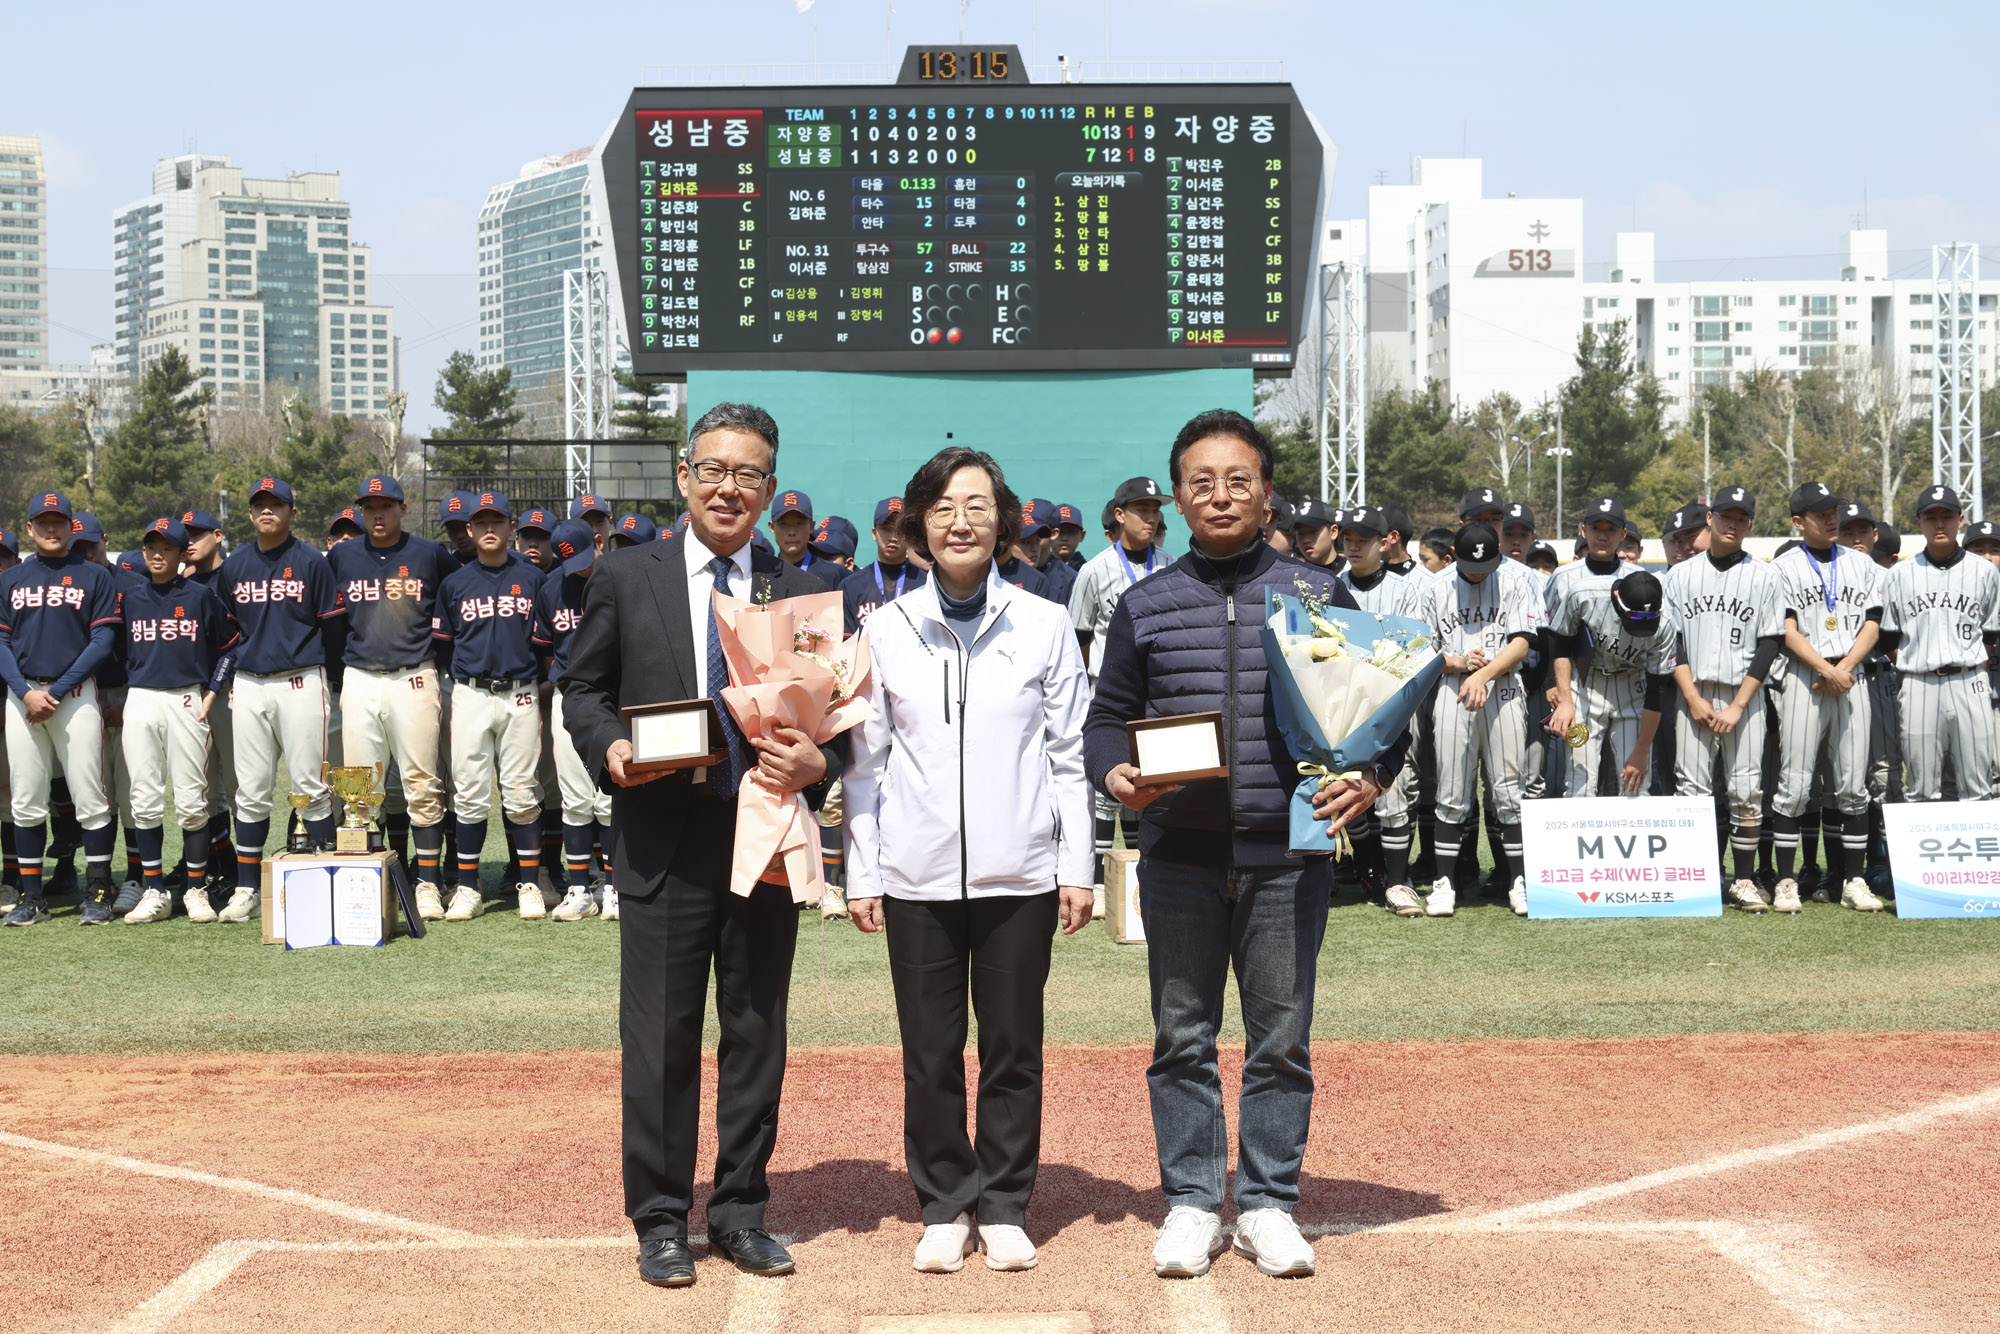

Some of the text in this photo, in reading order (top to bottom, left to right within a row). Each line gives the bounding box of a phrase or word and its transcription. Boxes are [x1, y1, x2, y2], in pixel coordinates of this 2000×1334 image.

[921, 52, 1009, 79] 13:15
[785, 107, 1075, 121] TEAM 1 2 3 4 5 6 7 8 9 10 11 12
[1086, 106, 1154, 118] R H E B
[649, 119, 749, 147] 성남중
[778, 125, 1155, 142] 자양중 1 0 4 0 2 0 3 10 13 1 9
[1175, 116, 1275, 143] 자양중
[778, 148, 1155, 164] 성남중 1 1 3 2 0 0 0 7 12 1 8
[660, 163, 752, 177] 강규명 SS
[1266, 160, 1281, 170] 2B
[661, 182, 754, 195] 김하준 2B
[861, 178, 936, 191] 타율 0.133
[954, 177, 1025, 190] 홈런 0
[1271, 178, 1278, 189] P
[790, 190, 825, 201] NO. 6
[661, 201, 751, 214] 김준화 C
[861, 197, 932, 209] 타수 15
[954, 196, 1025, 209] 타점 4
[1266, 198, 1280, 208] SS
[789, 207, 826, 220] 김하준
[660, 220, 754, 233] 방민석 3B
[862, 216, 932, 229] 안타 2
[954, 215, 1025, 228] 도루 0
[1270, 217, 1278, 227] C
[660, 239, 752, 252] 최정훈 LF
[1266, 235, 1281, 246] CF
[786, 245, 829, 256] NO. 31
[856, 243, 932, 255] 투구수 57
[952, 242, 1025, 254] BALL 22
[661, 258, 755, 271] 김범준 1B
[1267, 254, 1282, 265] 3B
[1508, 249, 1552, 271] 513
[789, 262, 827, 275] 이서준
[857, 261, 932, 274] 탈삼진 2
[949, 261, 1025, 272] STRIKE 35
[739, 277, 754, 288] CF
[1267, 273, 1281, 284] RF
[913, 287, 922, 302] B
[997, 285, 1008, 300] H
[1267, 292, 1282, 303] 1B
[662, 296, 752, 309] 김도현 P
[912, 307, 922, 323] S
[998, 307, 1007, 322] E
[1267, 311, 1279, 322] LF
[661, 315, 754, 328] 박찬서 RF
[662, 334, 699, 347] 김도현
[911, 328, 924, 344] O
[993, 328, 1014, 343] FC
[1796, 585, 1866, 610] JAYNG
[1683, 594, 1755, 624] JAYANG
[1908, 591, 1981, 620] JAYANG
[1843, 614, 1861, 631] 17
[1730, 628, 1741, 645] 9
[1955, 623, 1973, 640] 18
[1485, 632, 1506, 649] 27
[288, 676, 304, 690] 10
[408, 676, 424, 690] 16
[1971, 681, 1984, 694] 18
[515, 692, 533, 707] 25
[1500, 688, 1516, 701] 27
[183, 695, 192, 708] 2
[1545, 820, 1568, 830] 2025
[1577, 835, 1668, 860] MVP
[1541, 866, 1707, 883] 최고급 수제(WE) 글러브
[1605, 891, 1675, 904] KSM스포츠
